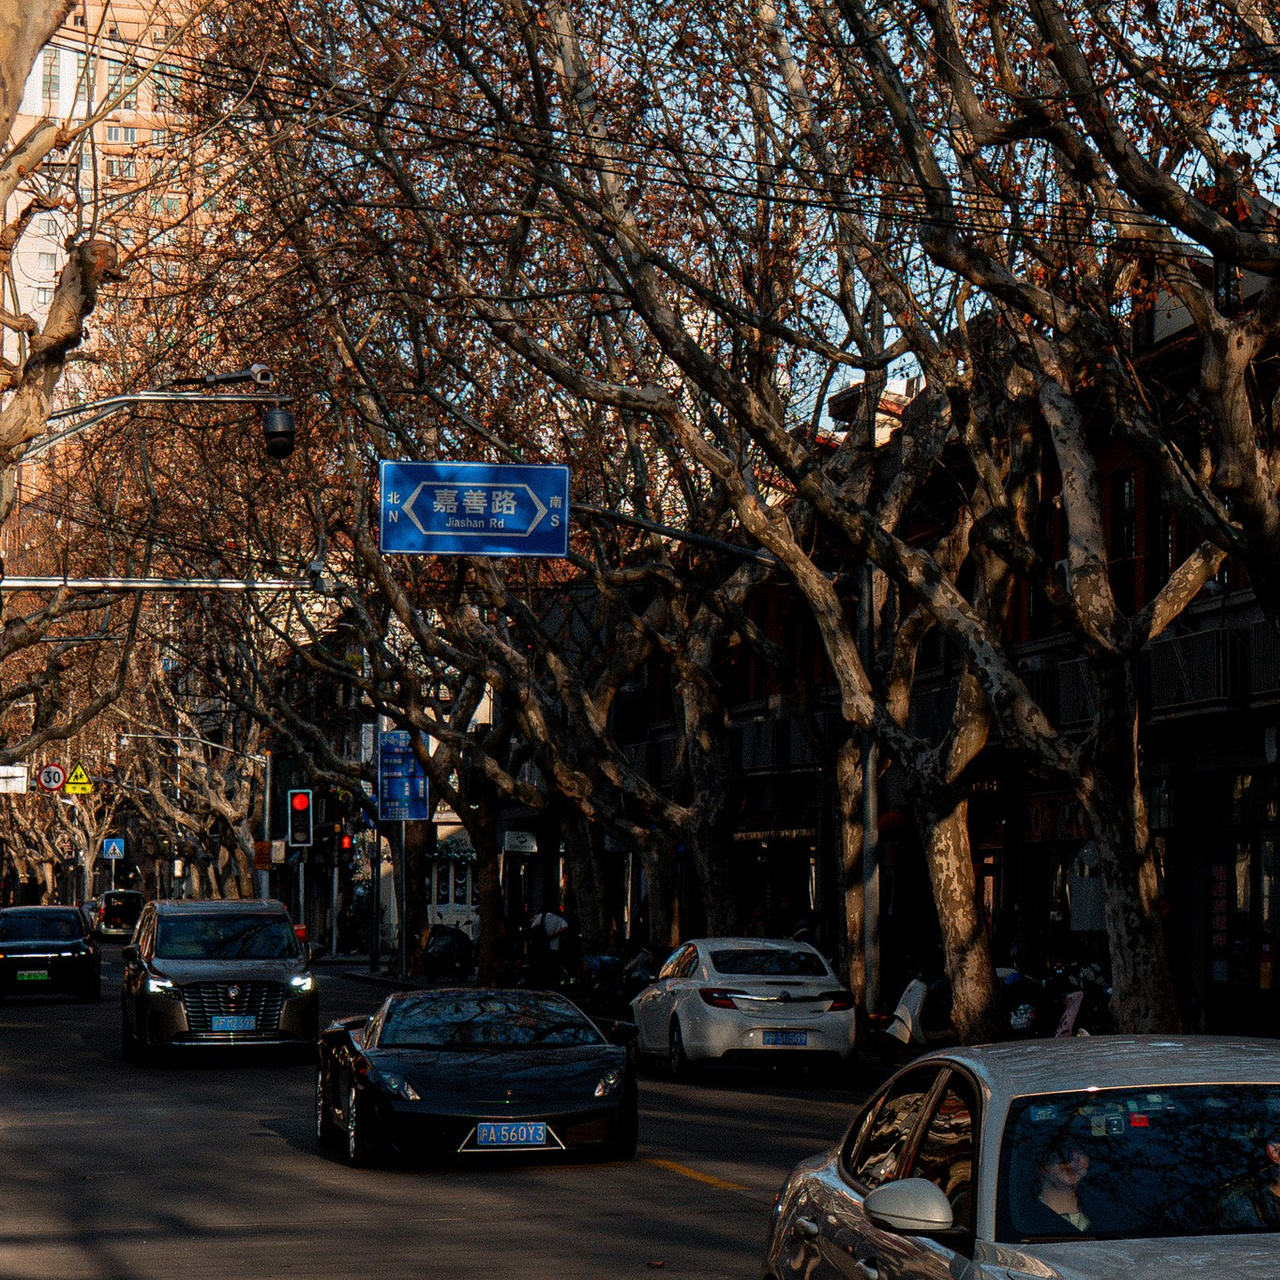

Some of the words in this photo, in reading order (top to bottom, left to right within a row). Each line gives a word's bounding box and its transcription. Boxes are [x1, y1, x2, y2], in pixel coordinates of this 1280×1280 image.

[387, 491, 400, 504] 北
[433, 489, 517, 515] 嘉善路
[549, 496, 562, 509] 南
[389, 510, 399, 522] N
[550, 514, 560, 527] S
[445, 518, 484, 528] Jiashan
[489, 518, 505, 529] Rd
[44, 771, 60, 783] 30
